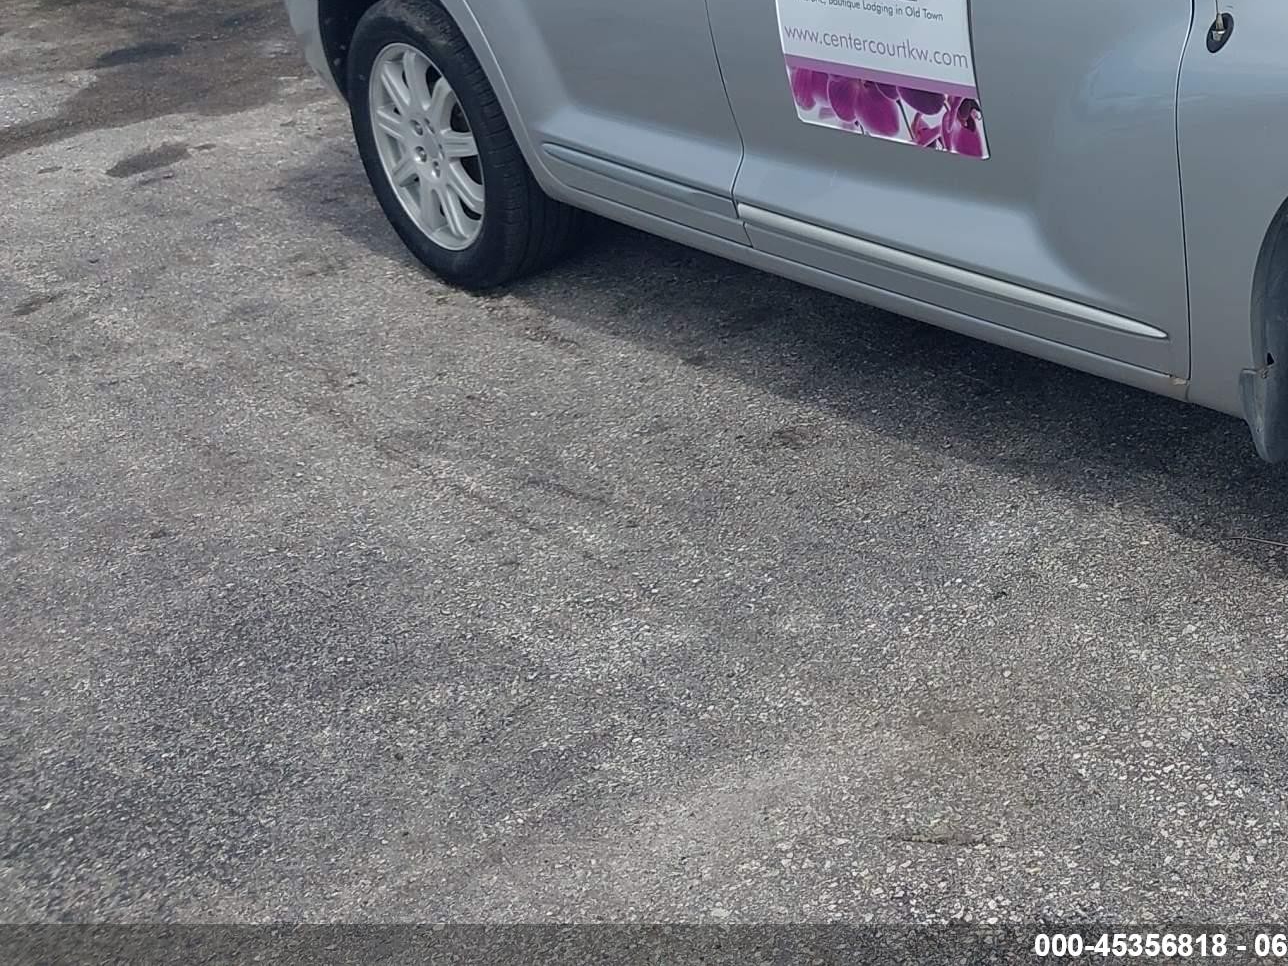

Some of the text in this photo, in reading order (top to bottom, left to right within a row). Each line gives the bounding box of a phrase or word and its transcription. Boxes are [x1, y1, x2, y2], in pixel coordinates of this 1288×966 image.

[862, 0, 894, 16] Lodging
[895, 4, 903, 15] in
[904, 5, 921, 18] Old
[922, 8, 944, 21] Town
[784, 25, 969, 69] www.centercourtkw.com
